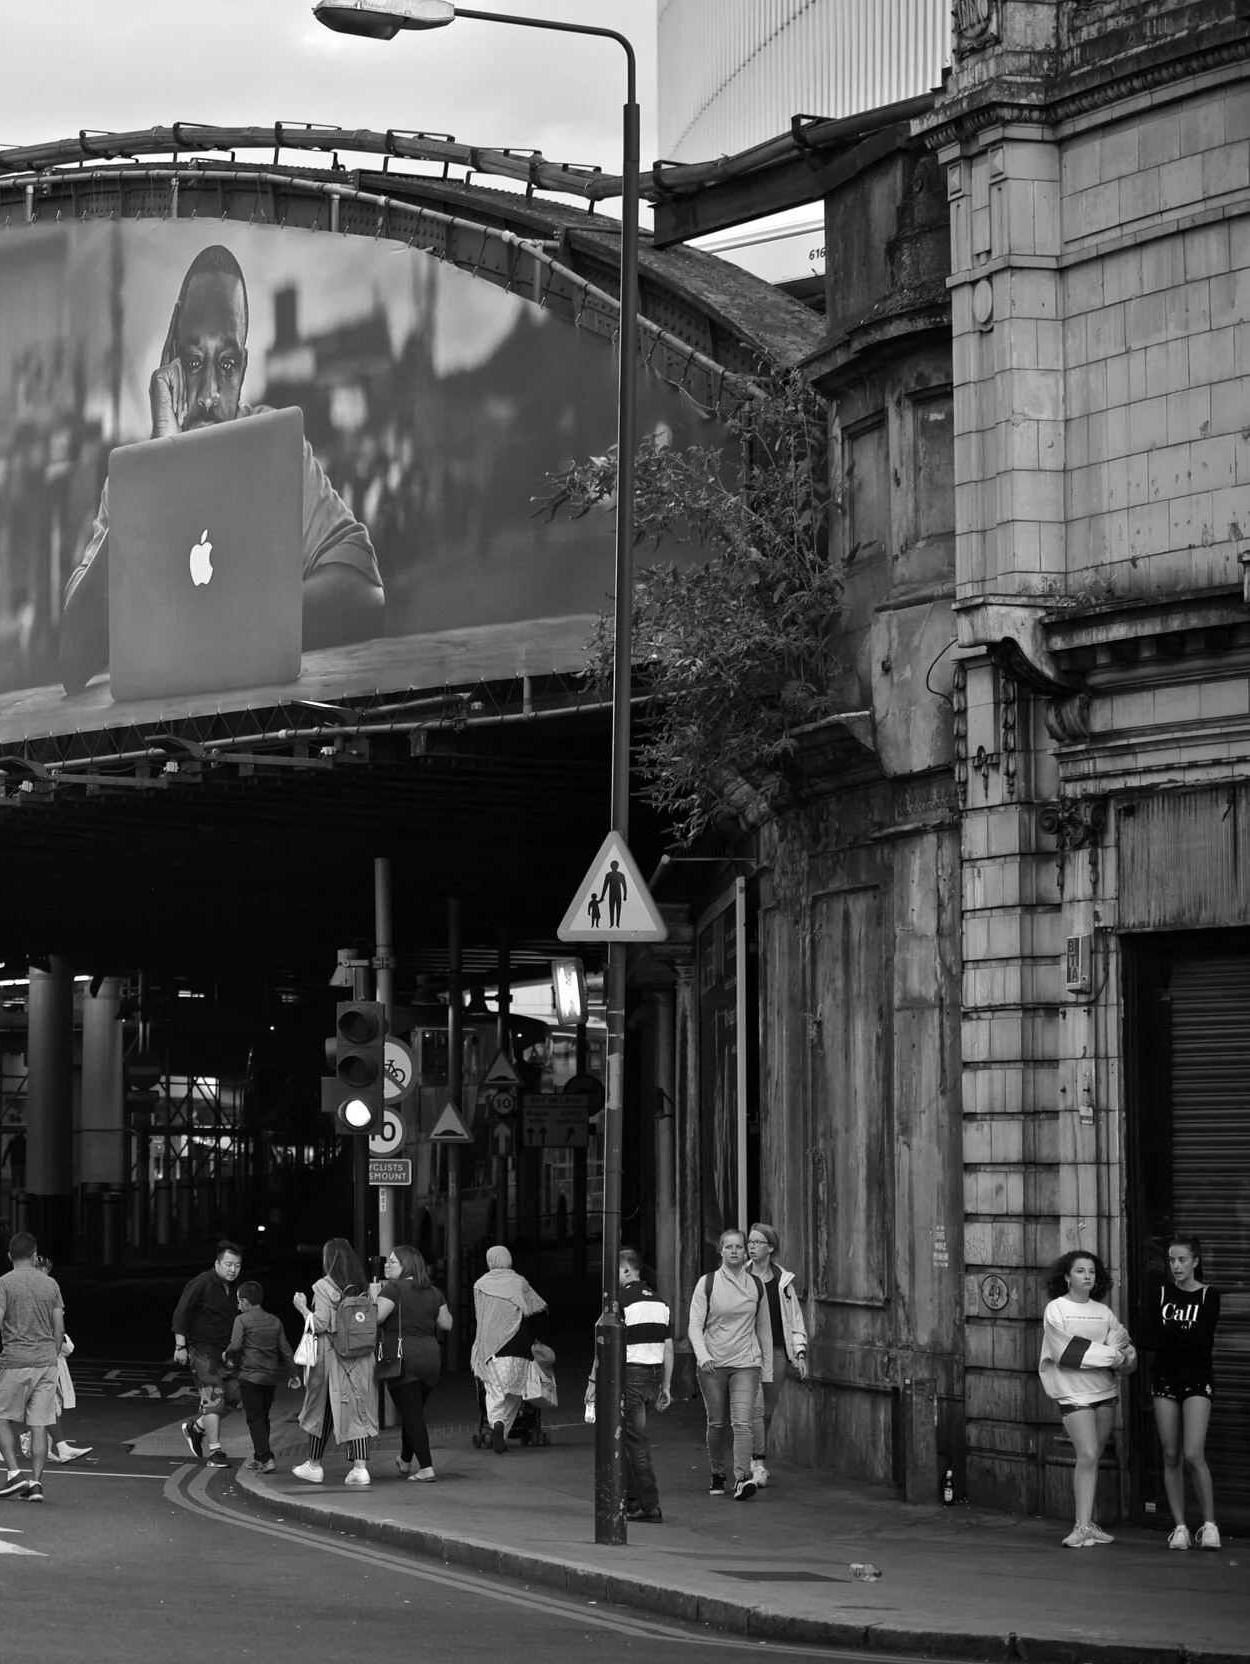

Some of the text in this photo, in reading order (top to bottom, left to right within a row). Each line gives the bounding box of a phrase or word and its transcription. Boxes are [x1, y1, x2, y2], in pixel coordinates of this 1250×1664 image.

[809, 247, 826, 260] 616
[496, 1098, 511, 1109] 10
[370, 1121, 397, 1142] 0
[369, 1163, 404, 1172] YCLISTS
[369, 1172, 407, 1180] SMOUNT
[1162, 1302, 1199, 1322] Call
